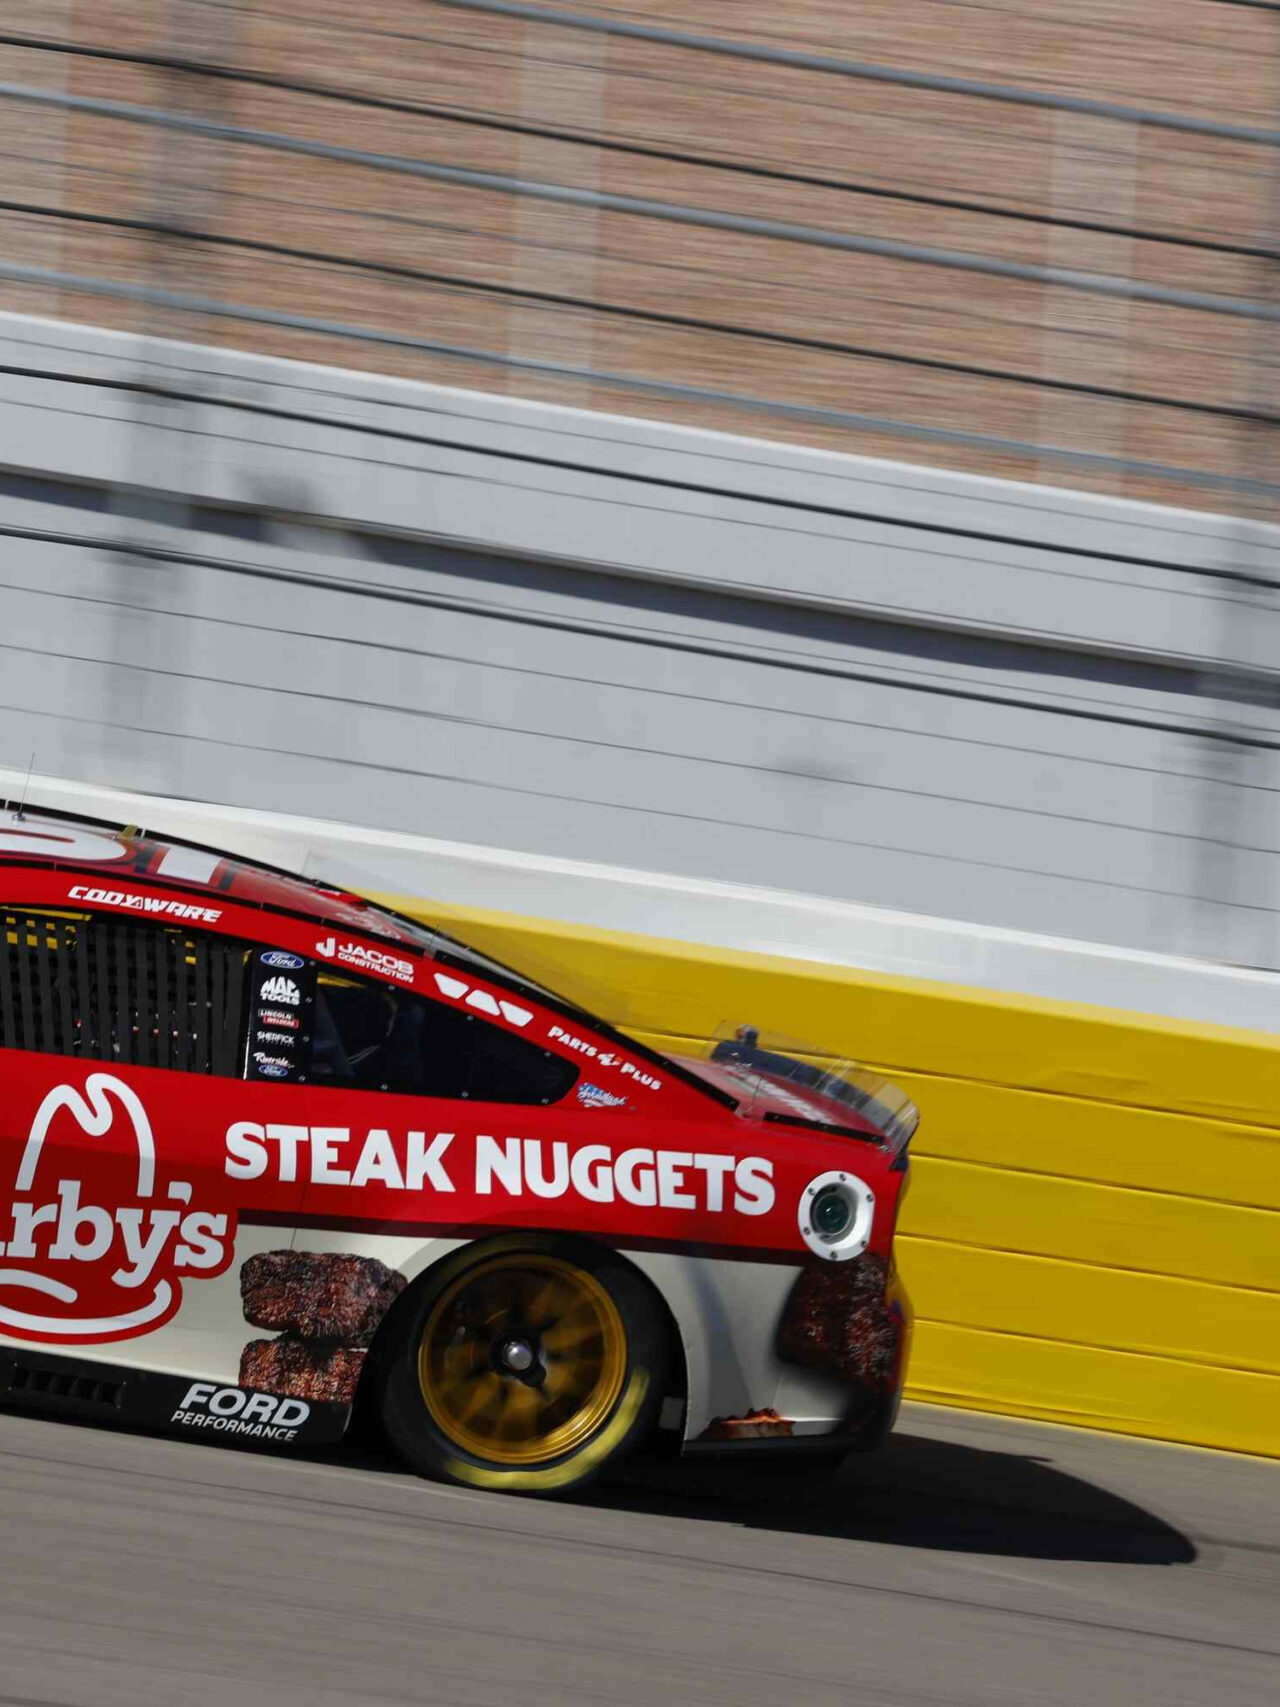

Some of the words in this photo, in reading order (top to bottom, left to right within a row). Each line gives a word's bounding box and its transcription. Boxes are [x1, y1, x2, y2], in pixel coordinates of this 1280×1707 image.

[265, 952, 300, 968] Ford
[338, 952, 414, 983] CONSTRUCTION
[260, 976, 300, 998] MAC
[260, 994, 300, 1006] TOOLS
[260, 1009, 293, 1020] LINCOLN
[225, 1121, 456, 1193] STEAK
[475, 1135, 776, 1216] NUGGETS
[179, 1382, 311, 1427] FORD
[171, 1410, 298, 1442] PERFORMANCE
